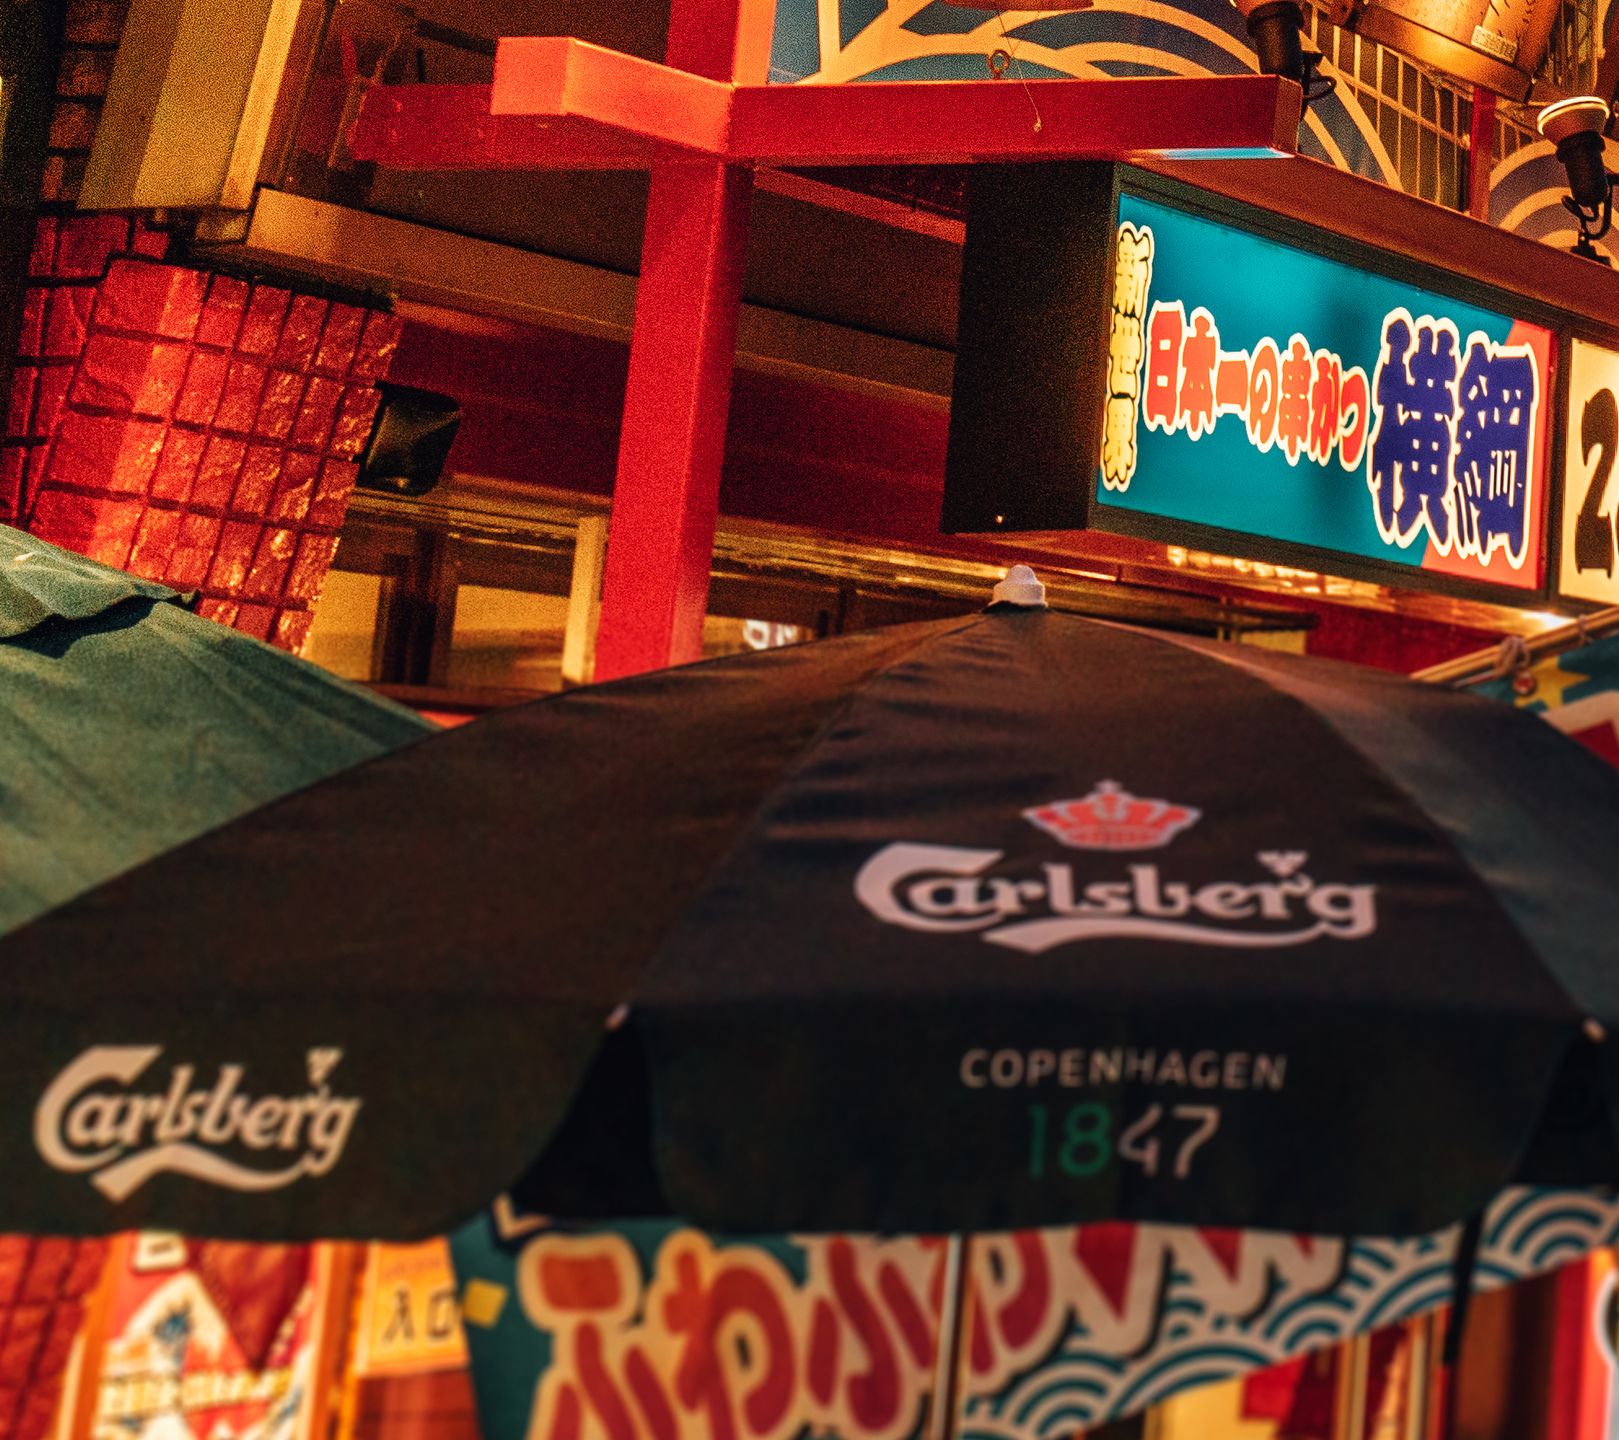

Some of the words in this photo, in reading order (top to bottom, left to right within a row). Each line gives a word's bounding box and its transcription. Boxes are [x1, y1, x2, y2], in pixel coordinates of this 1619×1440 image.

[1102, 222, 1153, 490] 新世界
[1147, 300, 1368, 470] 日本一の串かつ
[1371, 310, 1536, 569] 横綱
[856, 842, 1378, 953] Carlsberg
[36, 1045, 361, 1201] Carlsberg
[961, 1048, 1287, 1089] COPENHAGEN
[1026, 1102, 1221, 1180] 1847
